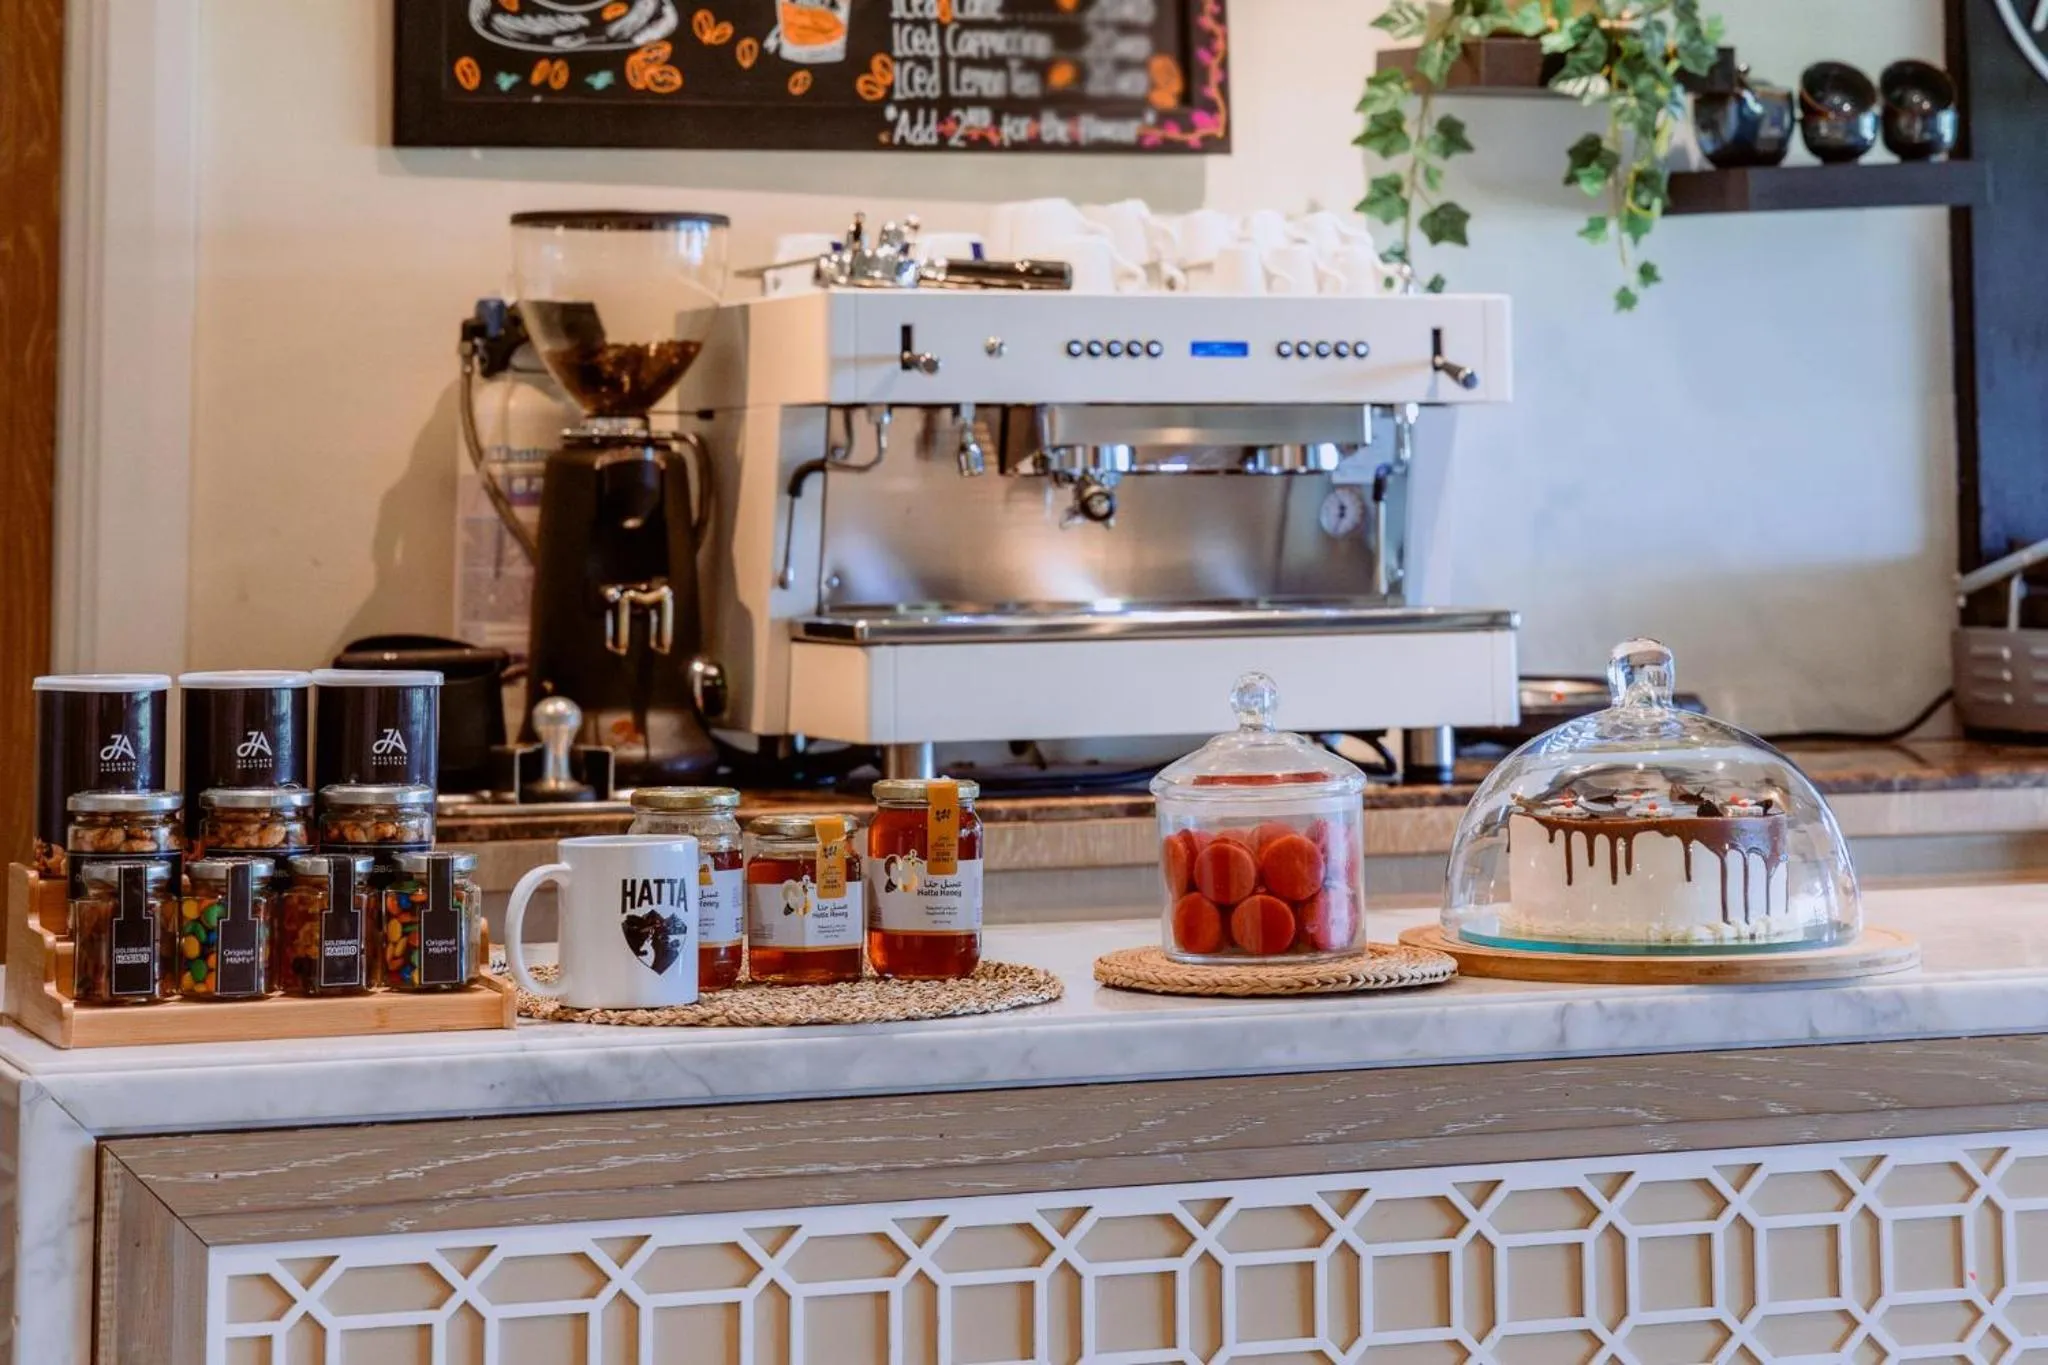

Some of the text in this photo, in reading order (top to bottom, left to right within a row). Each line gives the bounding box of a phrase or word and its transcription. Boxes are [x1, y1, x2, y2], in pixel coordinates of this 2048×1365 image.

[893, 58, 942, 99] Iced
[100, 733, 136, 761] JA
[236, 731, 273, 757] JA
[372, 728, 408, 754] JA
[621, 878, 688, 914] HATTA
[940, 889, 962, 898] Honey
[223, 948, 254, 957] Original
[425, 938, 456, 947] Original
